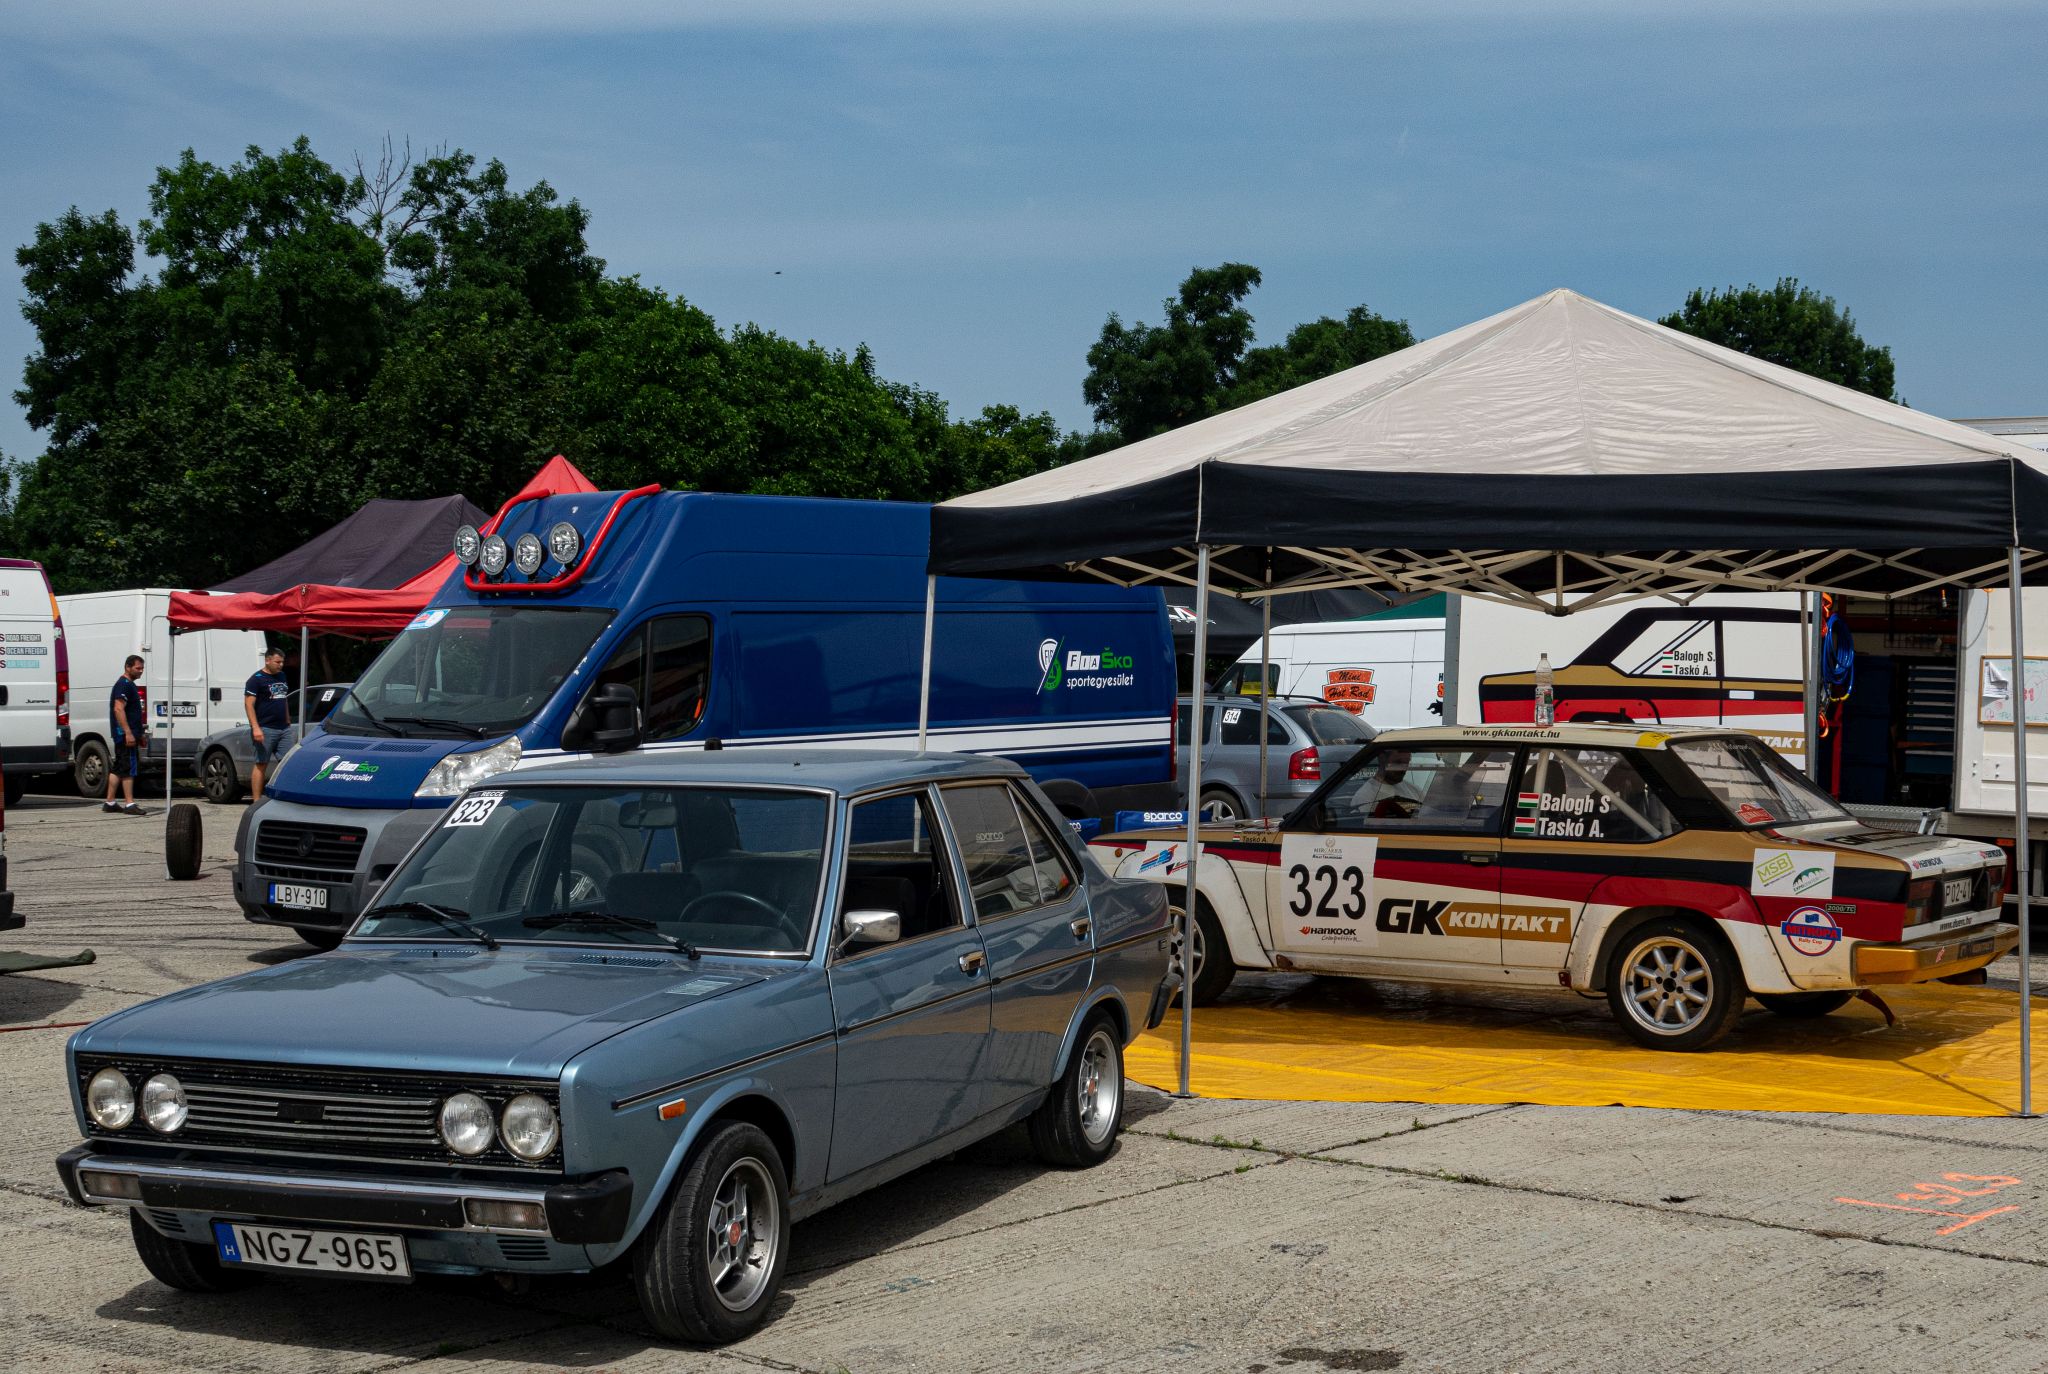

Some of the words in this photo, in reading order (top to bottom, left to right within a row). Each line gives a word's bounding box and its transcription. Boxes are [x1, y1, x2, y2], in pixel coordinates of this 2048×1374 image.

[6, 647, 24, 655] OCEAN
[25, 647, 47, 655] FREIGHT
[1674, 651, 1704, 663] Balogh
[1707, 651, 1716, 662] S.
[1339, 671, 1361, 681] Mini
[1674, 664, 1699, 676] Taskó
[1702, 665, 1711, 676] A.
[1066, 673, 1134, 690] sportegyesület
[1328, 687, 1346, 698] Hot
[1349, 686, 1370, 698] Rod
[1224, 711, 1239, 722] 314
[1462, 729, 1561, 739] www.gkkontakt.hu
[450, 799, 495, 824] 323
[1540, 794, 1594, 815] Balogh
[1143, 811, 1183, 822] sparco
[1538, 817, 1584, 837] Taskó
[1588, 819, 1605, 838] A.
[1757, 858, 1789, 877] MSB
[277, 885, 326, 906] LBY-910
[1288, 864, 1367, 920] 323
[1375, 898, 1450, 936] GK
[1449, 911, 1564, 933] KONTAKT
[1786, 924, 1839, 938] MITROPA
[224, 1244, 236, 1256] H
[240, 1229, 397, 1272] NGZ-965
